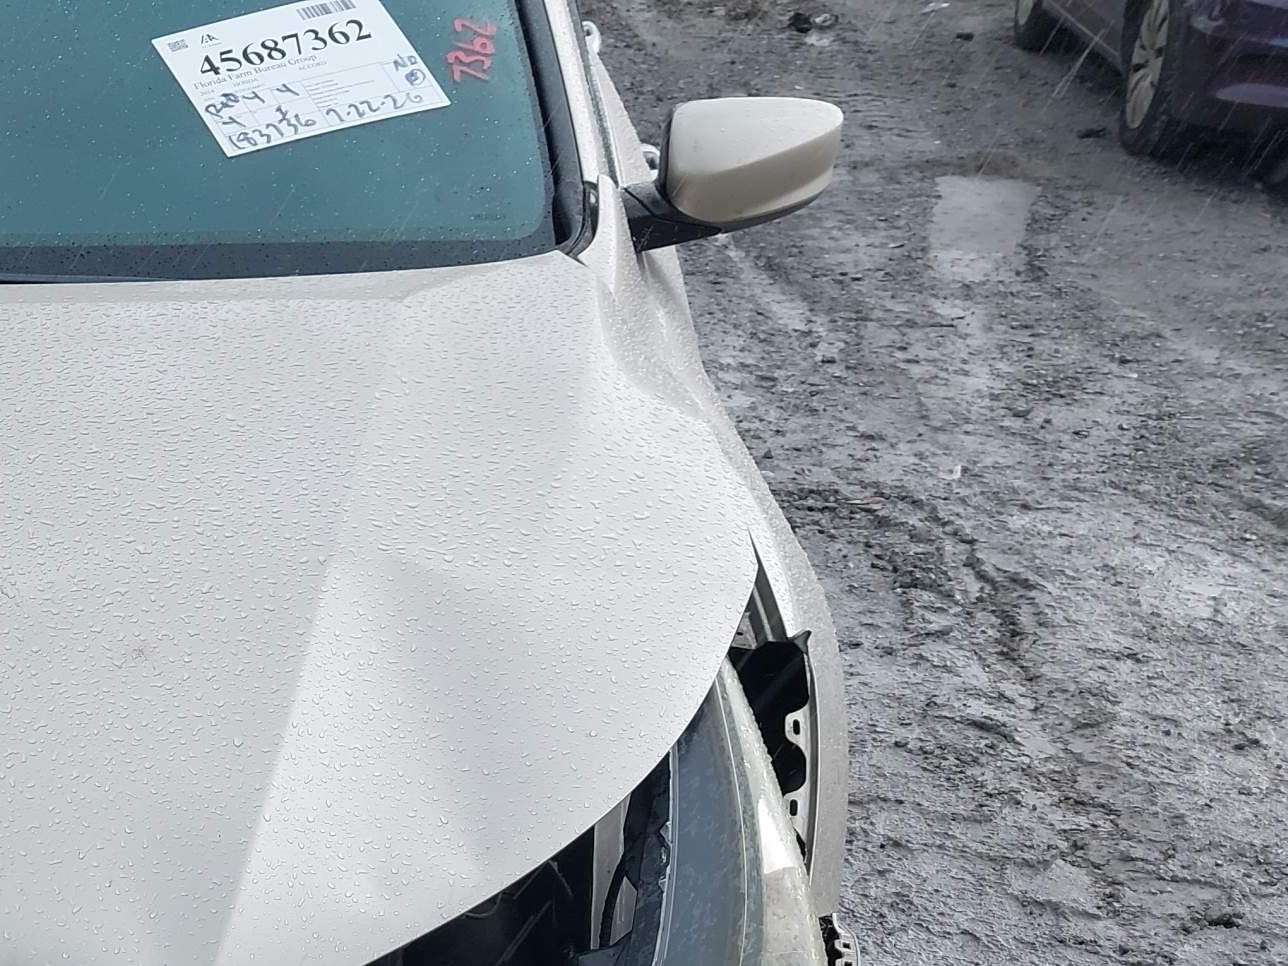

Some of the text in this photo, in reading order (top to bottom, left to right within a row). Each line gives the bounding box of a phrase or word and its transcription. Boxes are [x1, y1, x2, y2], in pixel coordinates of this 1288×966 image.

[193, 78, 227, 91] Florida
[227, 69, 253, 82] Farm
[254, 60, 287, 74] Bureau
[287, 54, 318, 67] Group
[199, 18, 372, 76] 45687362
[446, 17, 497, 82] 7362
